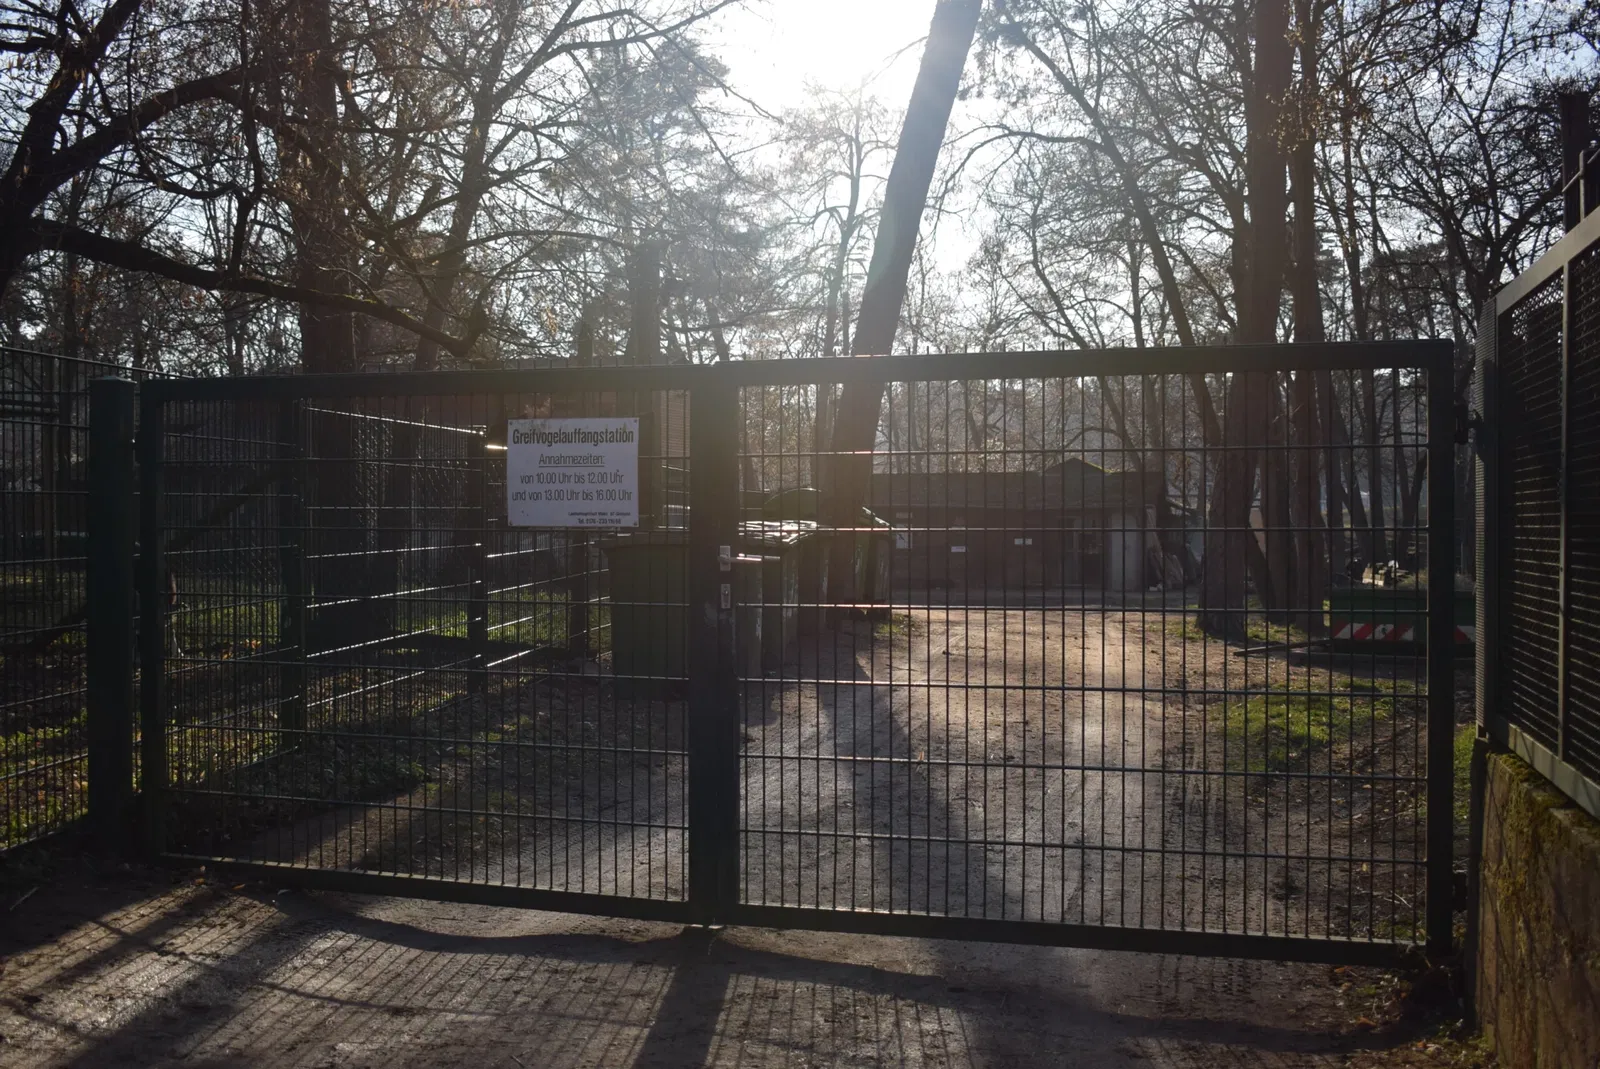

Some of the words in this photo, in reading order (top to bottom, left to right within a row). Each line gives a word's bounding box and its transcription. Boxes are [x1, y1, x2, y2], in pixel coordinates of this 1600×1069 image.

[512, 428, 634, 447] Greifvogelauffangstation
[539, 453, 605, 465] Annahmezeiten:
[520, 474, 534, 484] von
[536, 472, 557, 484] 10.00
[558, 472, 572, 484] Uhr
[574, 472, 585, 484] bis
[587, 472, 608, 484] 12.00
[610, 471, 624, 484] Uhr
[512, 489, 526, 501] und
[528, 491, 542, 501] von
[544, 489, 564, 501] 13.00
[566, 489, 580, 501] Uhr
[582, 489, 593, 501] bis
[596, 489, 616, 501] 16.00
[618, 489, 633, 501] Uhr
